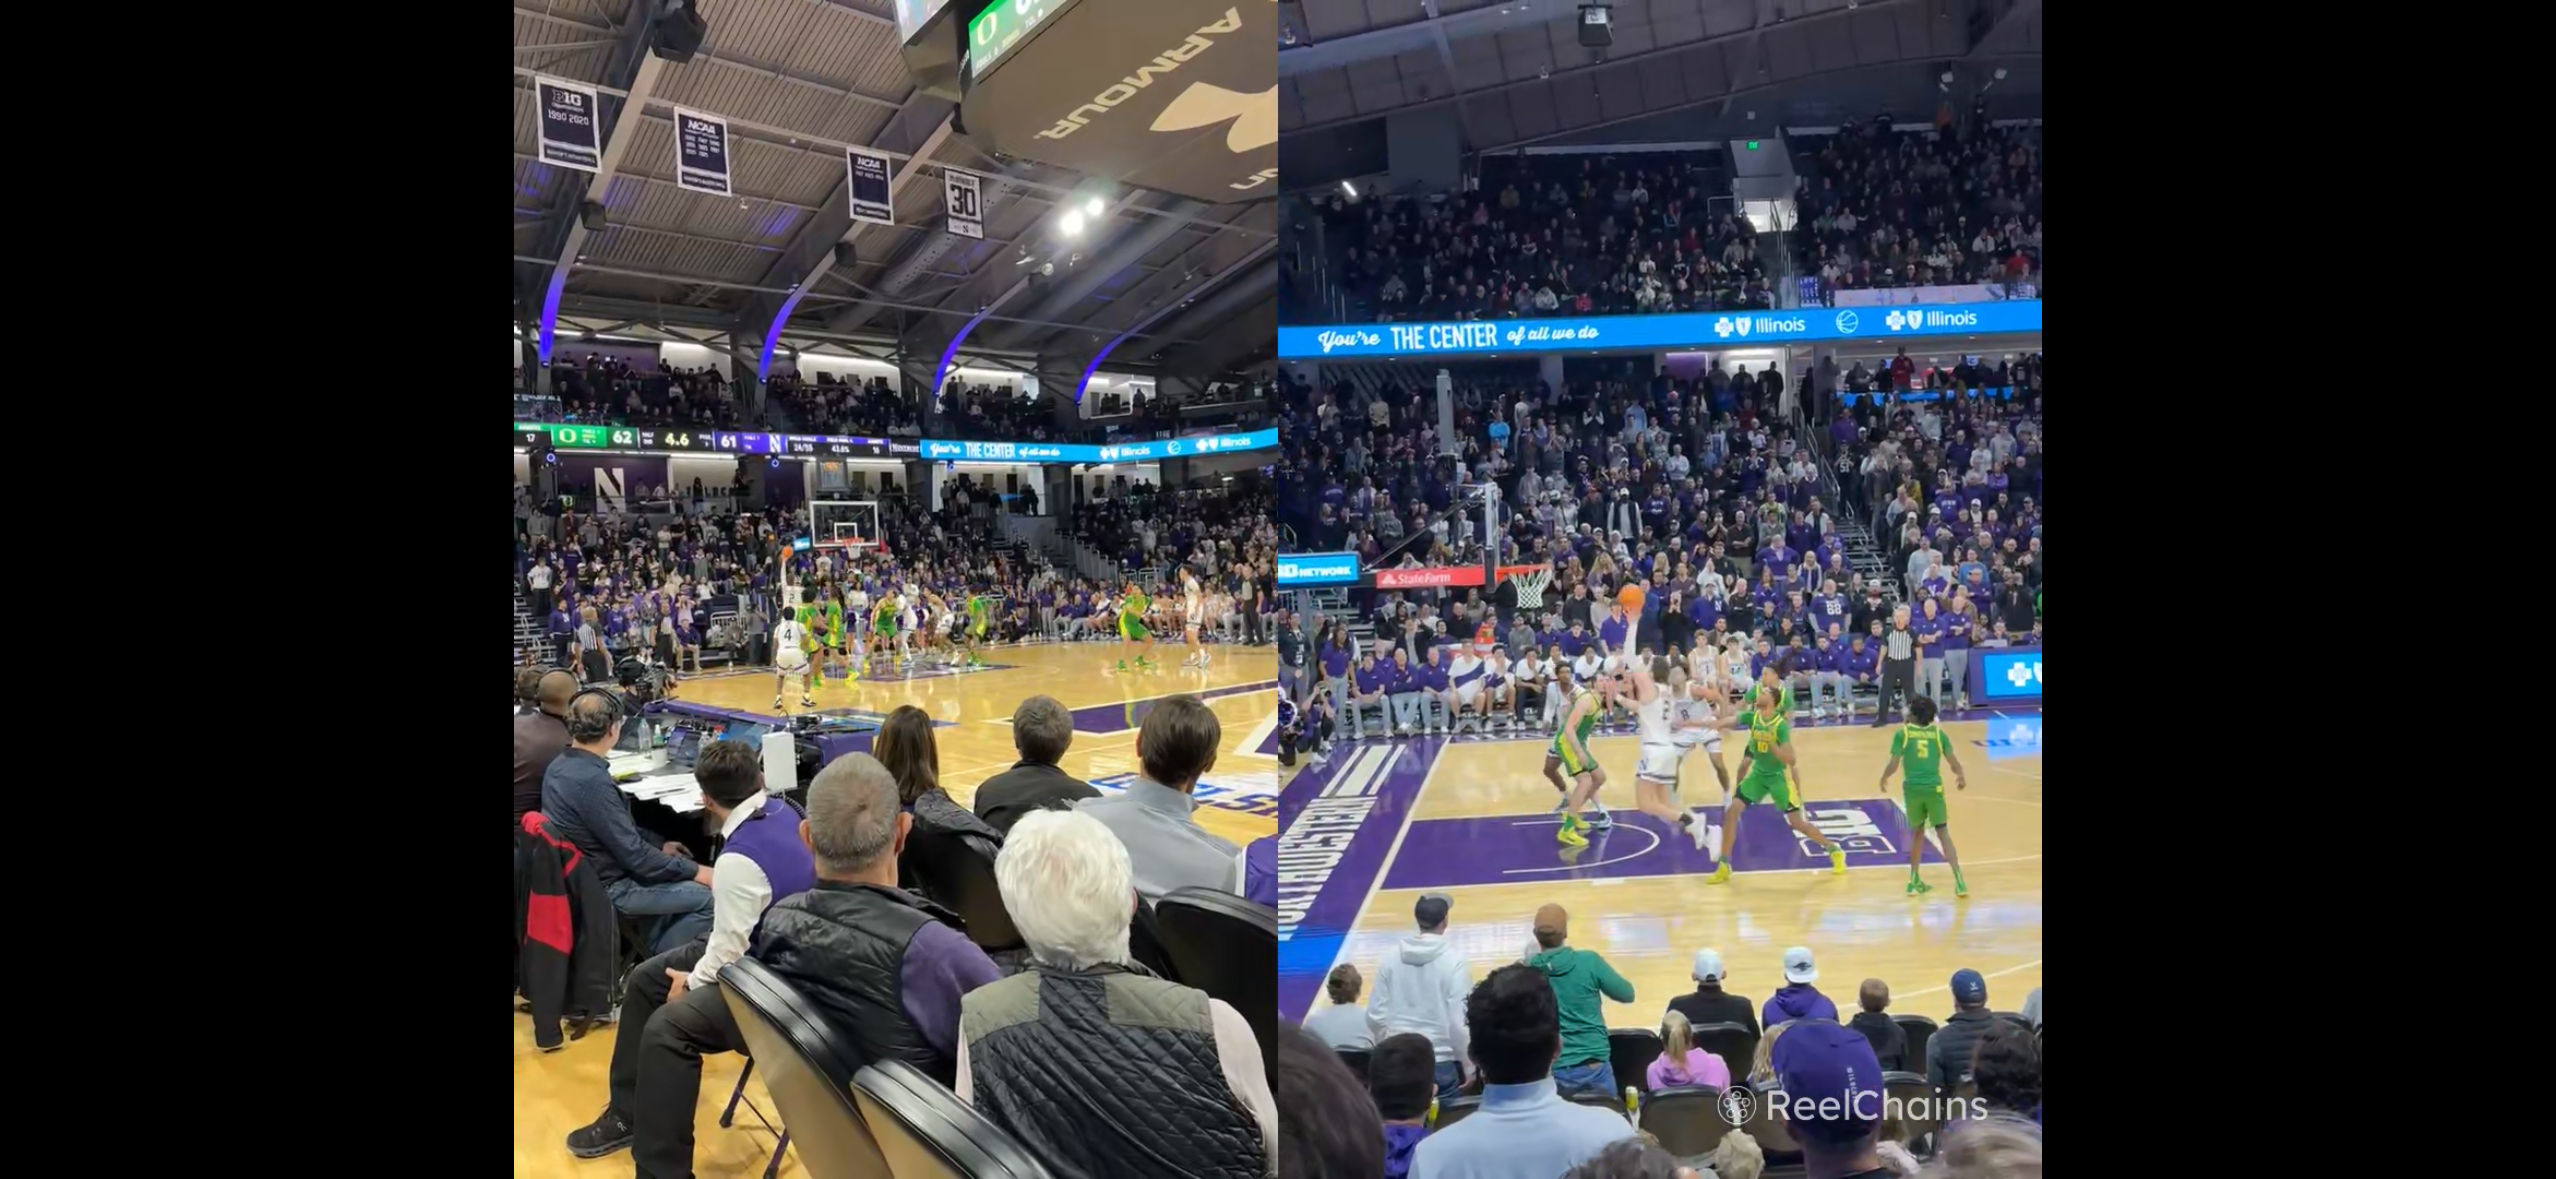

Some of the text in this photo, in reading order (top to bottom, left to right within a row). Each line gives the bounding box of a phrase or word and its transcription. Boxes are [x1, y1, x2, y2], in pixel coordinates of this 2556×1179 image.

[1042, 6, 1243, 140] ARMOUR
[687, 119, 716, 135] NCAA
[857, 157, 881, 169] NCAA
[950, 183, 976, 217] 30
[1755, 317, 1806, 334] Illinois
[1927, 310, 1977, 327] Illinois
[1390, 326, 1425, 350] THE
[1429, 323, 1498, 348] CENTER
[1506, 326, 1525, 345] of
[1528, 326, 1550, 341] all
[1551, 328, 1576, 340] we
[1577, 325, 1599, 339] do
[612, 430, 633, 445] 62
[664, 431, 690, 446] 4.6
[720, 434, 737, 449] 61
[768, 433, 781, 453] N
[1220, 436, 1251, 448] Illinois
[965, 442, 982, 457] THE
[984, 443, 1016, 458] CENTER
[1120, 447, 1151, 458] Illinois
[594, 467, 627, 514] N
[1299, 565, 1352, 577] NETWORK
[784, 629, 791, 641] 4
[1917, 740, 1928, 758] 5
